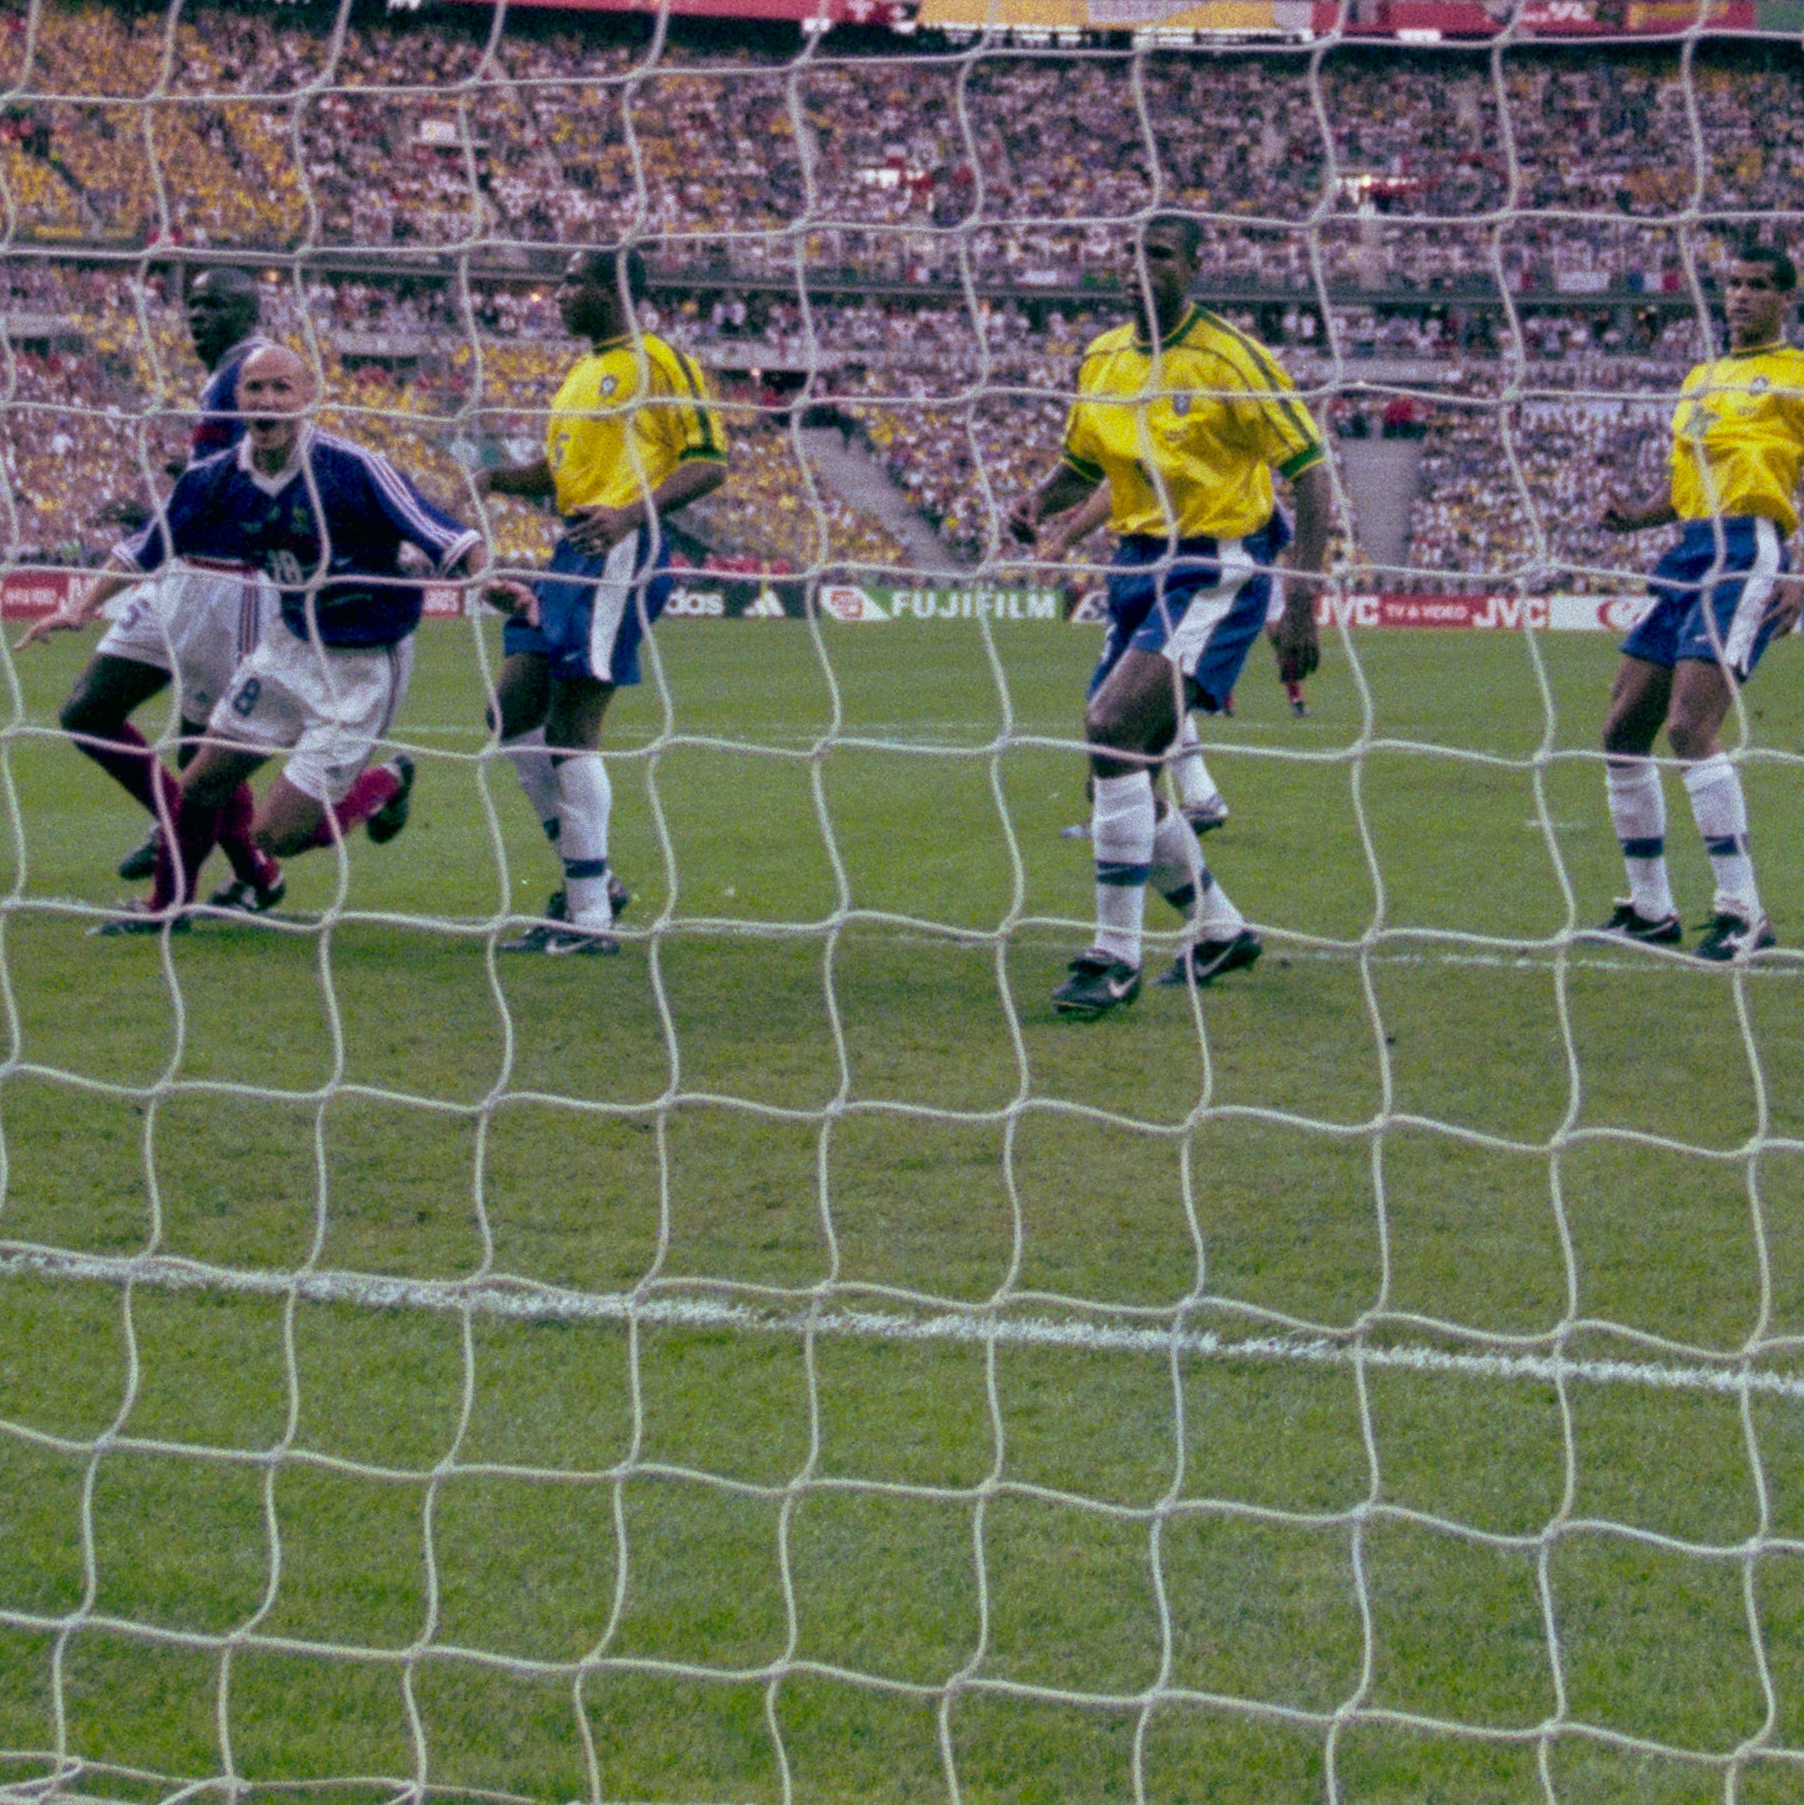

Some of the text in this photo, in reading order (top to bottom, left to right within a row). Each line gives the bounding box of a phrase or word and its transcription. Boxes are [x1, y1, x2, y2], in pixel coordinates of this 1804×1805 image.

[892, 591, 1056, 619] FUJIFILM
[1316, 595, 1379, 626] JVC
[1472, 597, 1546, 627] JVC
